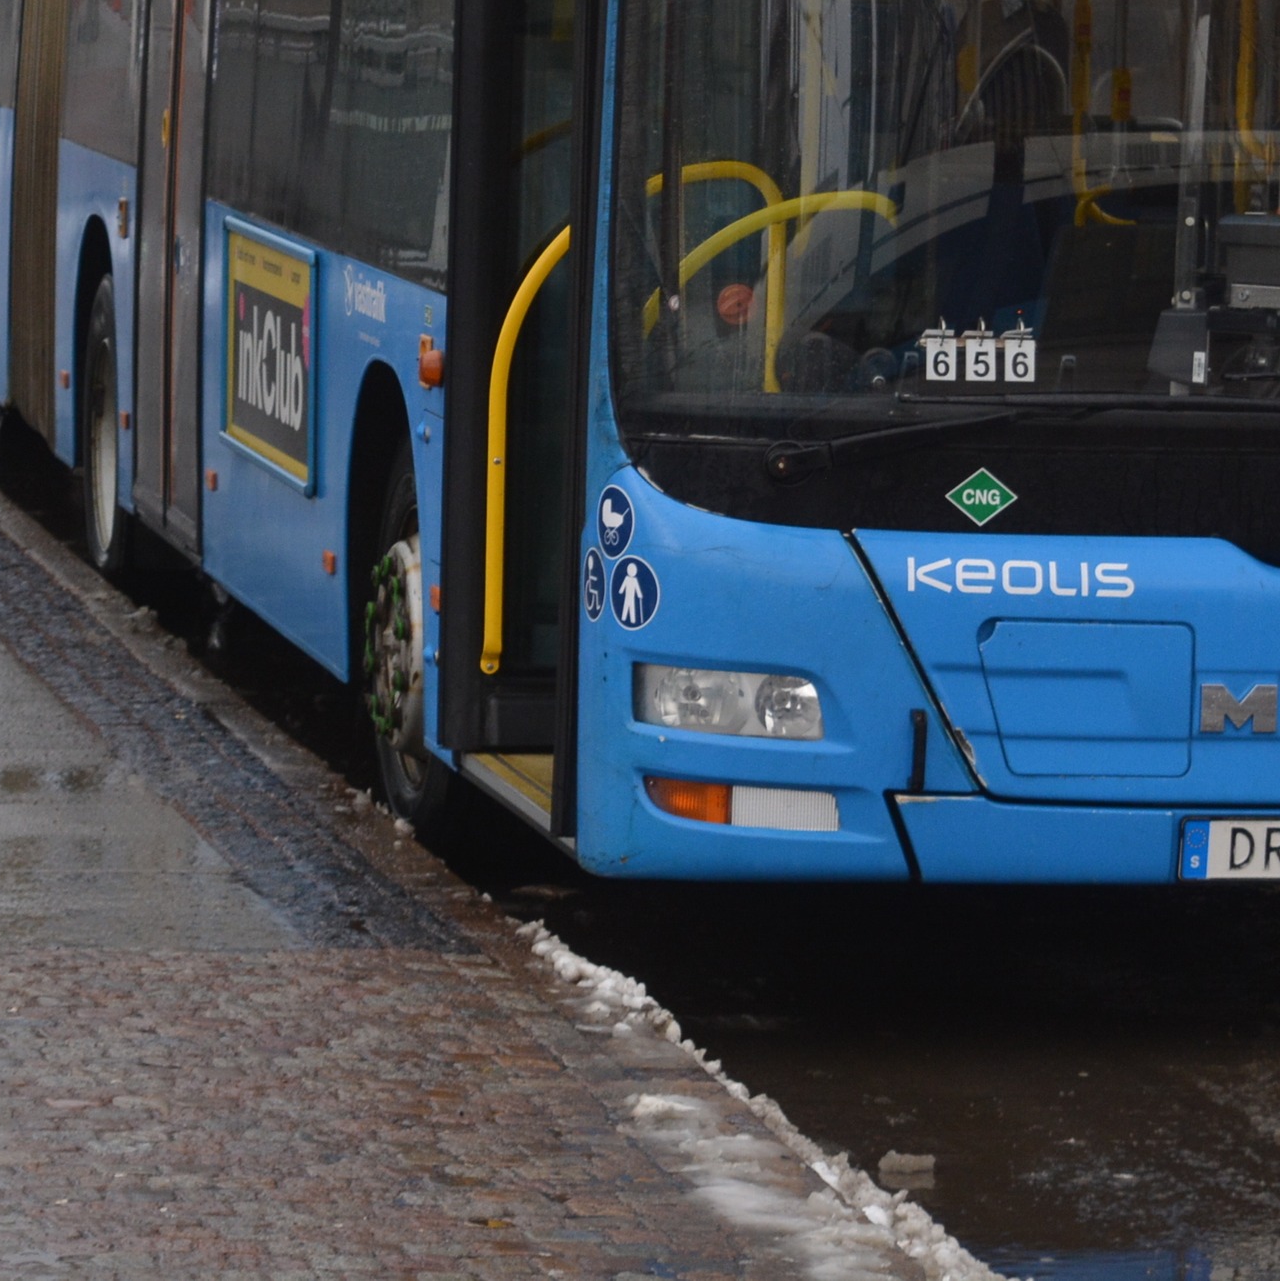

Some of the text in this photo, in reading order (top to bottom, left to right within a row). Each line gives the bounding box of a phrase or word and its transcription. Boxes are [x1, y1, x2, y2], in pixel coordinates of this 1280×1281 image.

[238, 291, 304, 432] inkClub
[962, 488, 1001, 505] CNG
[1189, 855, 1200, 869] S
